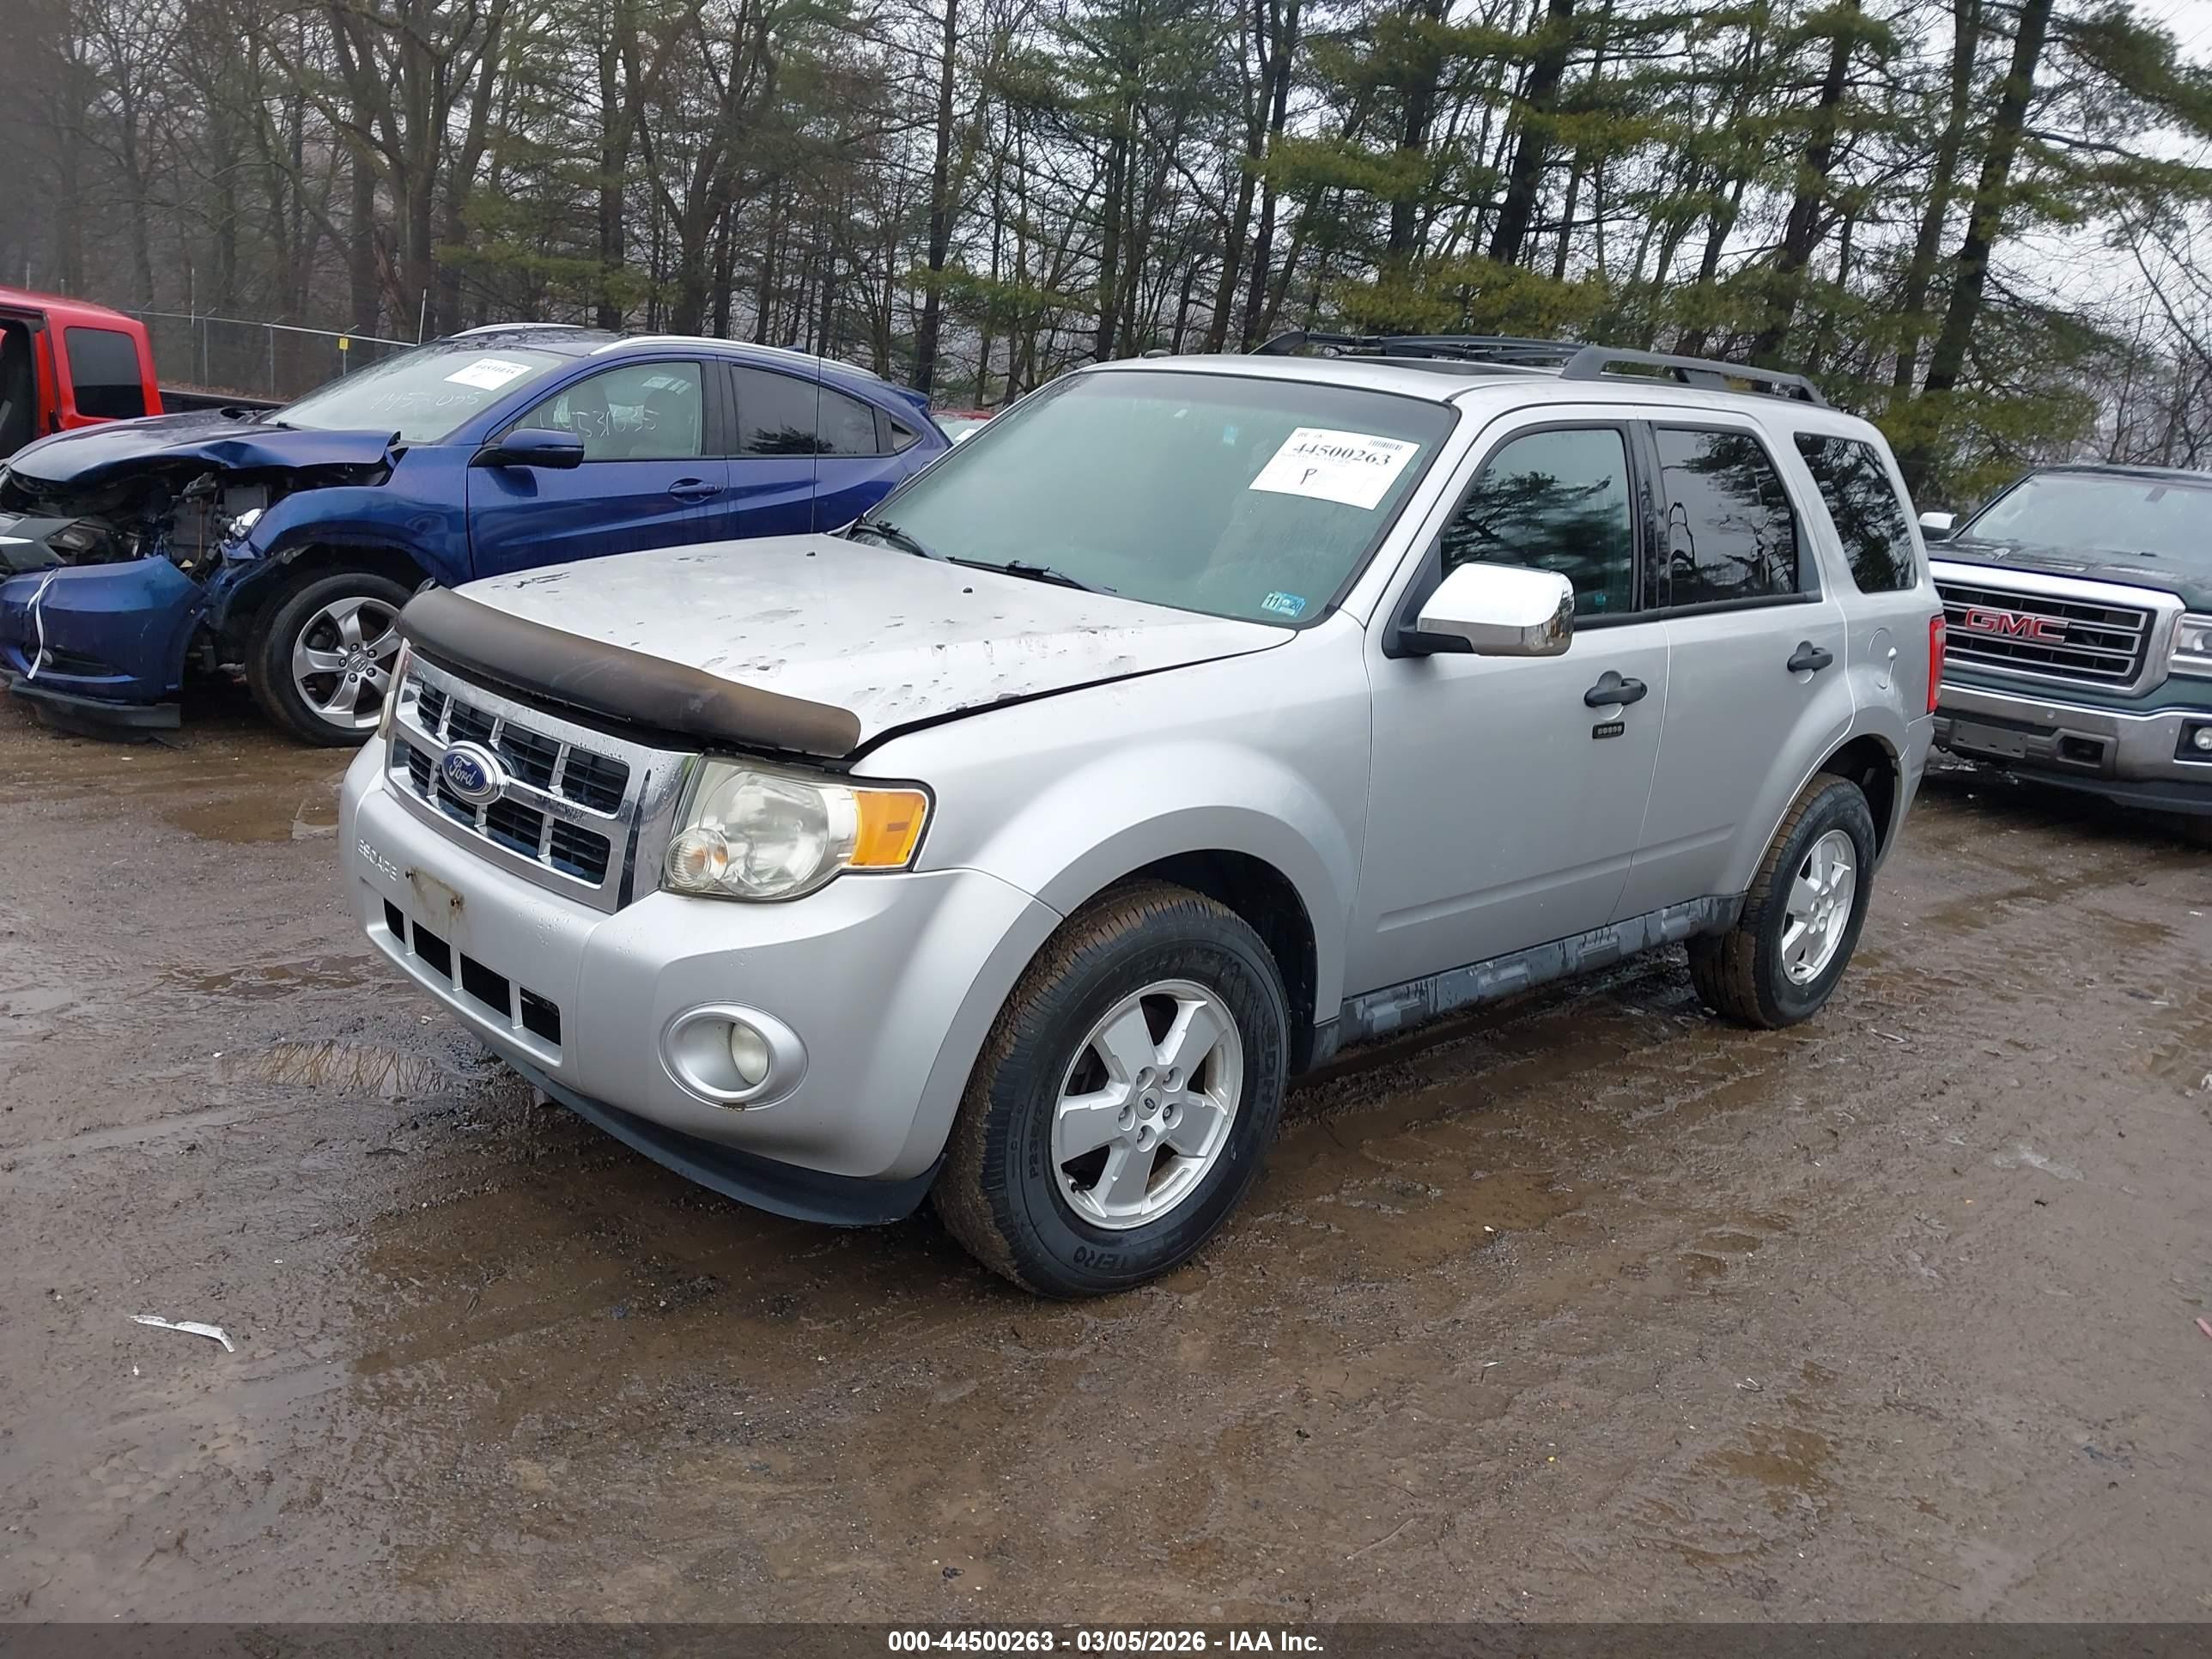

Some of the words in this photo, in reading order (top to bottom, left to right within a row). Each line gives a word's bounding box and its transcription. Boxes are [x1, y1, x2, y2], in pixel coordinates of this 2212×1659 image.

[1292, 441, 1392, 465] 44500263
[1300, 468, 1318, 485] P
[1965, 608, 2069, 645] GMC
[448, 756, 477, 787] Ford
